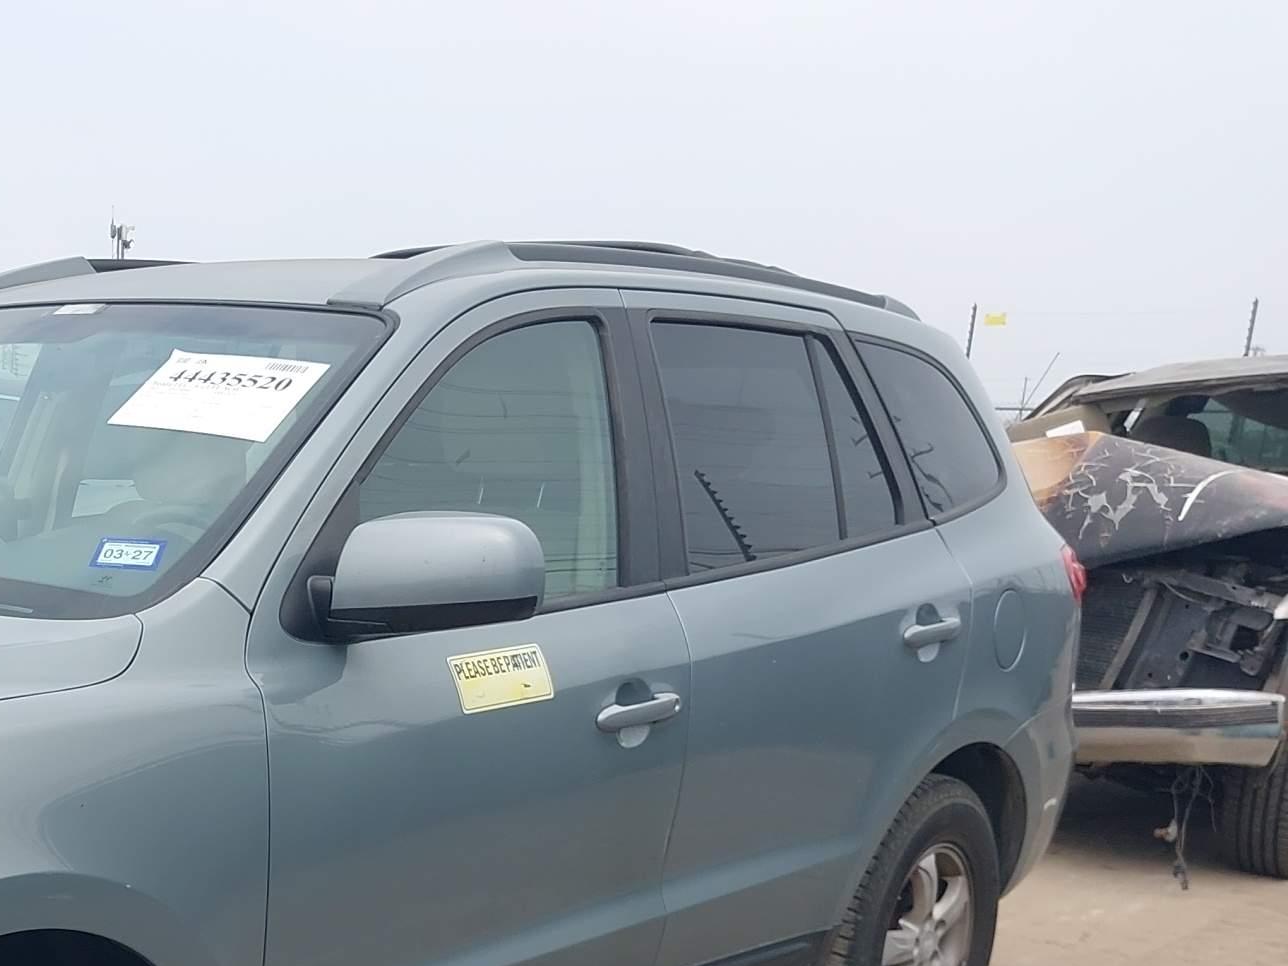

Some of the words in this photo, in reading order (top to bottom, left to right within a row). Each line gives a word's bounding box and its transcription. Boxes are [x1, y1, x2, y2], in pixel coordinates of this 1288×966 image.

[169, 369, 293, 391] 44435520
[453, 658, 493, 681] PLEASE
[490, 657, 506, 674] BE
[503, 650, 541, 672] PATIENT
